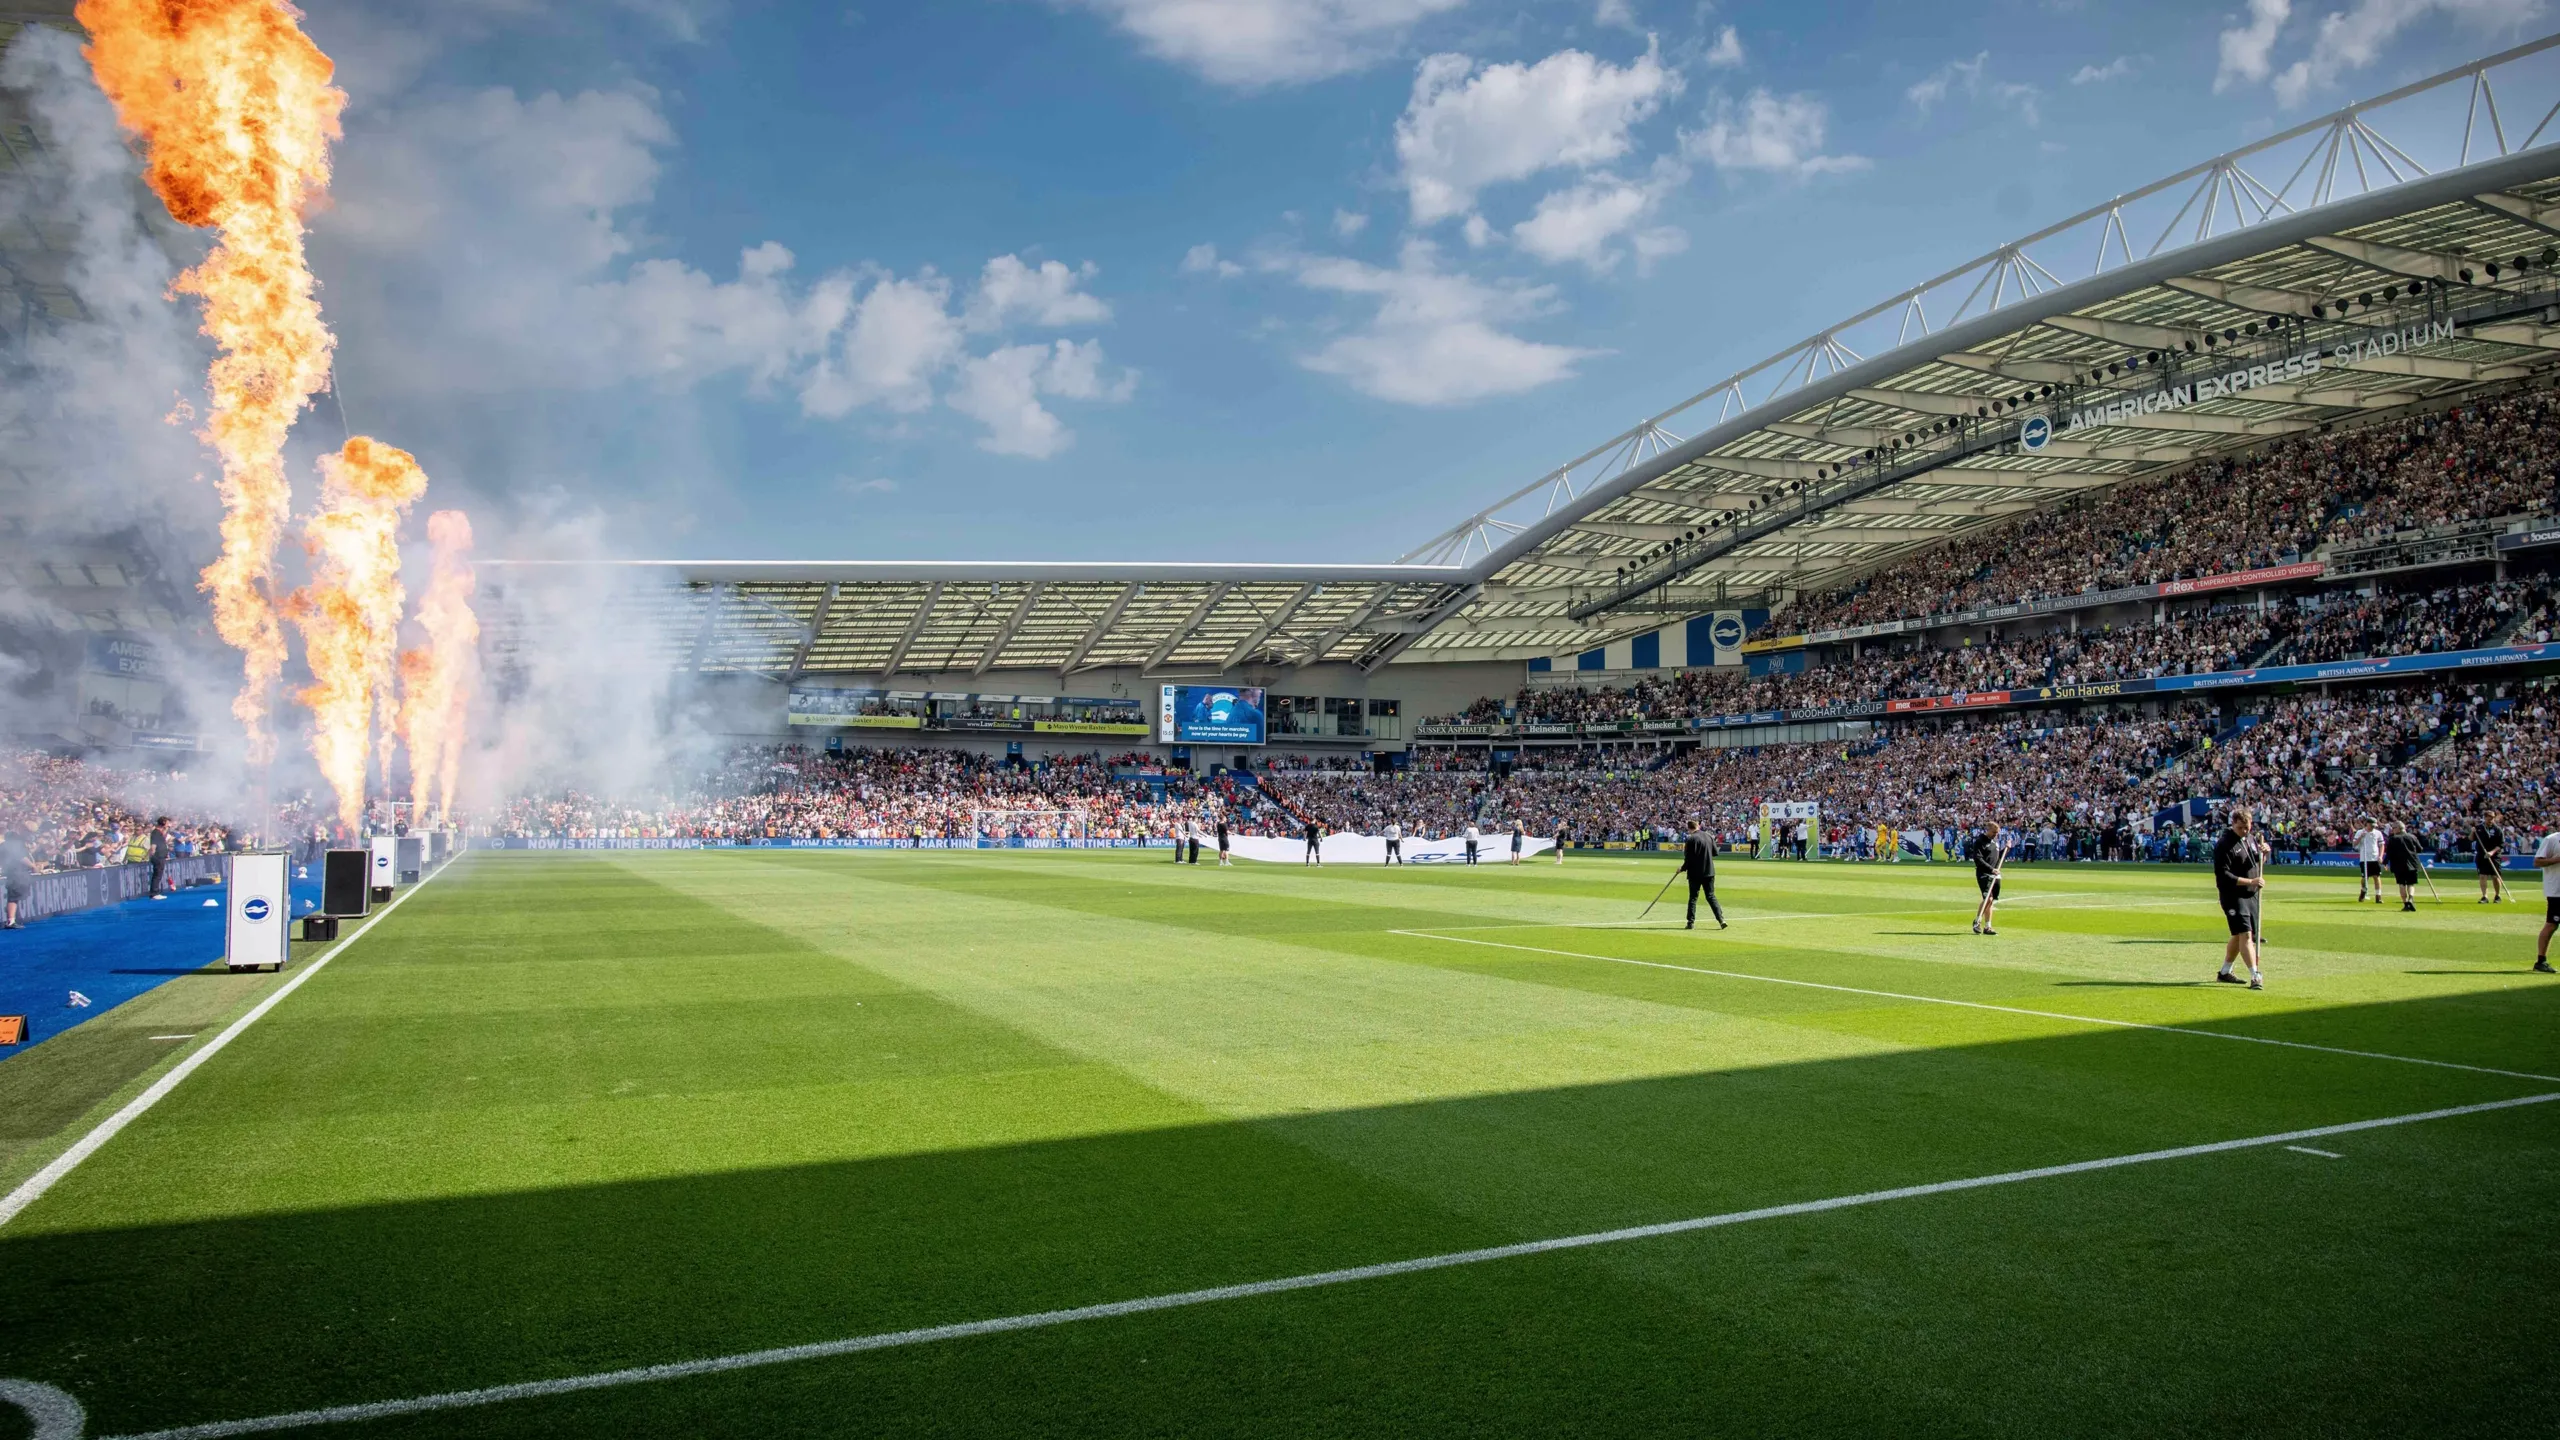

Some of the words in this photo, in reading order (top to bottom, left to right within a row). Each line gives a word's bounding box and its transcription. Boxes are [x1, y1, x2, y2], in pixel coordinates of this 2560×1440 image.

[2068, 384, 2191, 431] AMERICAN
[2197, 351, 2322, 401] EXPRESS
[2334, 317, 2455, 367] STADIUM
[2173, 581, 2194, 593] Rex
[2196, 576, 2241, 588] TEMPERATURE
[2242, 569, 2287, 582] CONTROLLED
[2037, 602, 2052, 611] THE
[2054, 594, 2108, 609] MONTEFIORE
[2111, 589, 2149, 600] HOSPITAL
[1906, 621, 1921, 629] FOSTER
[1940, 616, 1953, 624] SALES
[2461, 656, 2493, 665] BRITISH
[2495, 653, 2529, 662] AIRWAYS
[2318, 668, 2345, 677] BRITISH
[2347, 665, 2376, 674] AIRWAYS
[2193, 679, 2217, 687] BRITISH
[2218, 677, 2244, 686] AIRWAYS
[2055, 686, 2074, 698] Sun
[2078, 683, 2121, 697] Harvest
[1791, 707, 1841, 719] WOODHART
[1846, 703, 1882, 714] GROUP
[1053, 722, 1068, 731] Mayo
[1069, 723, 1088, 732] Wynne
[1417, 726, 1445, 734] SUSSEX
[1448, 725, 1487, 733] ASPHALTE
[1529, 725, 1567, 733] Heineken
[1585, 724, 1617, 732] Heineken
[527, 839, 560, 849] NOW
[562, 839, 575, 849] IS
[579, 839, 604, 849] THE
[608, 839, 640, 849] TIME
[643, 839, 668, 849] FOR
[1024, 839, 1048, 848] NOW
[1086, 839, 1112, 848] TIME
[36, 874, 88, 916] MARCHING
